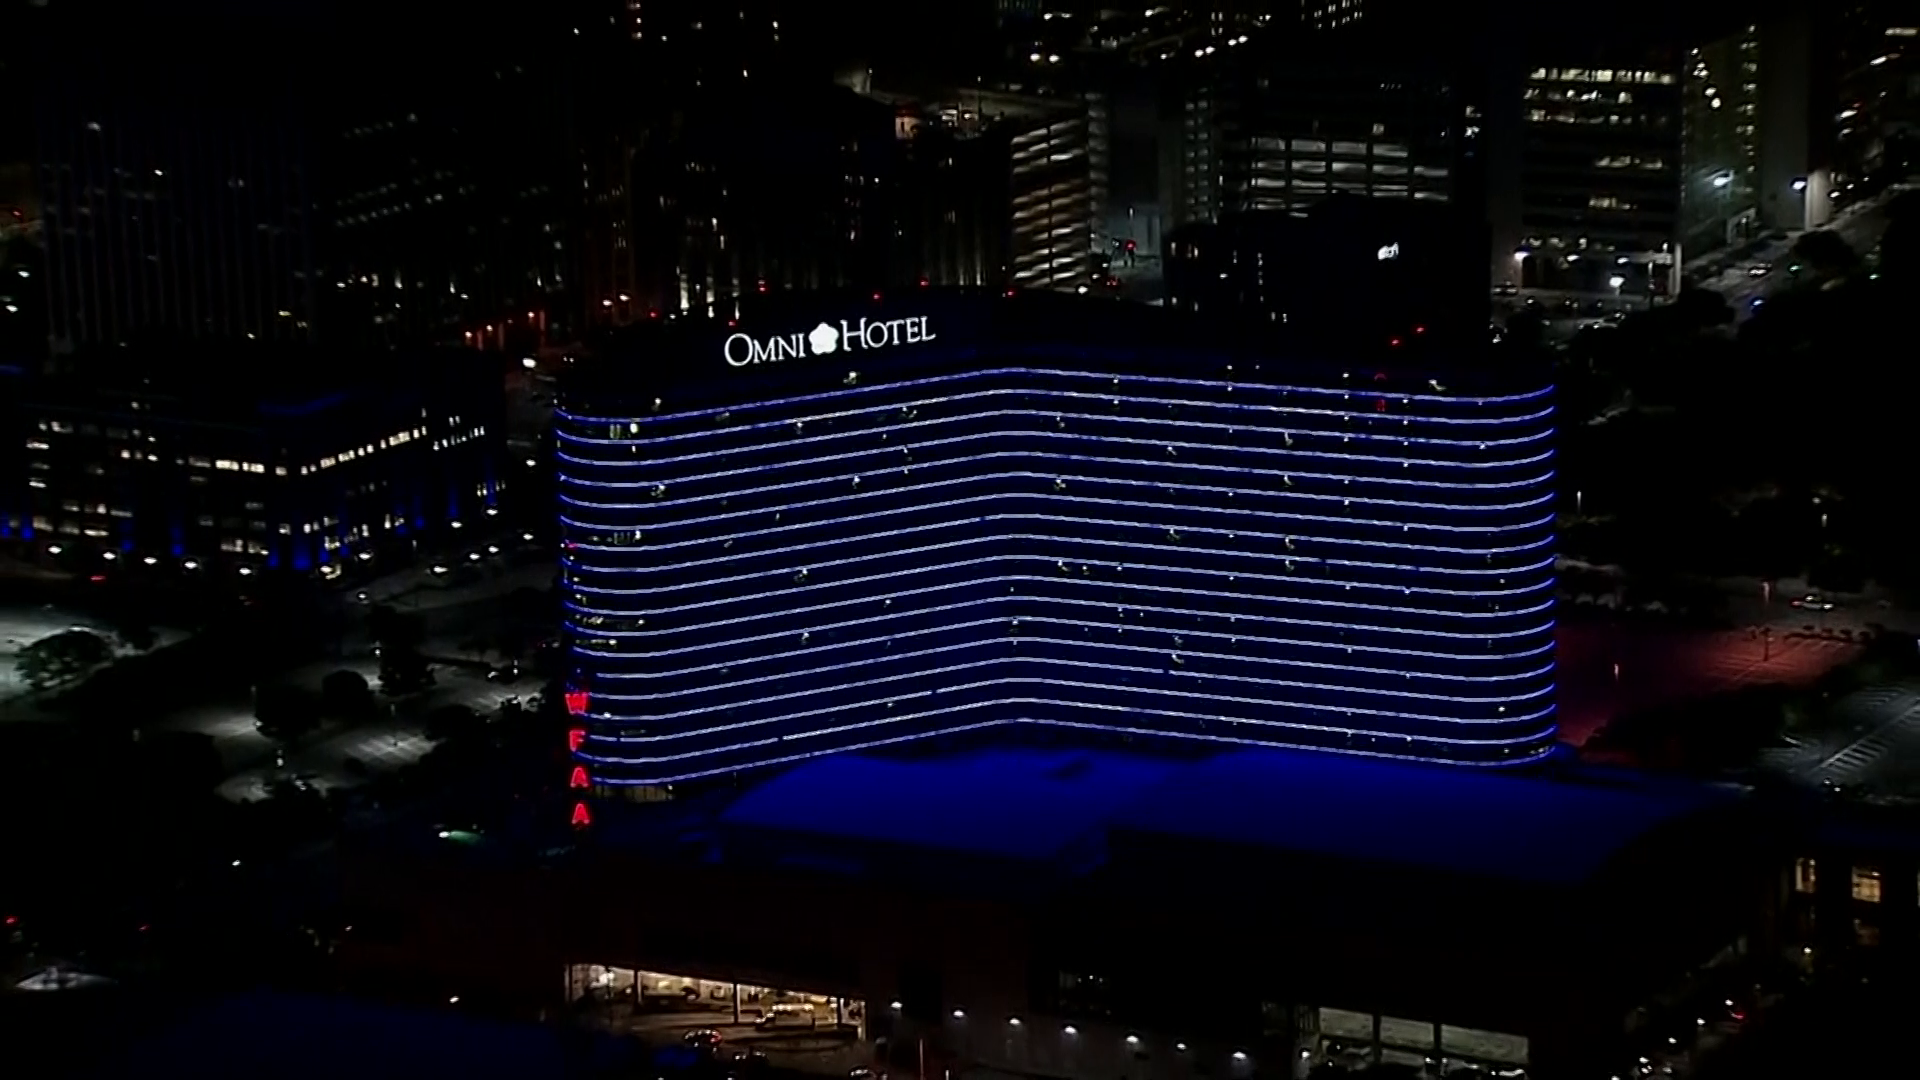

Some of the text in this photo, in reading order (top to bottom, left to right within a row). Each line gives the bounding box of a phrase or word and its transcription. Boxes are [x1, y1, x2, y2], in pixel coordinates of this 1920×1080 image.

[724, 316, 937, 367] OMNI HOTEL
[564, 691, 591, 825] WFAA
